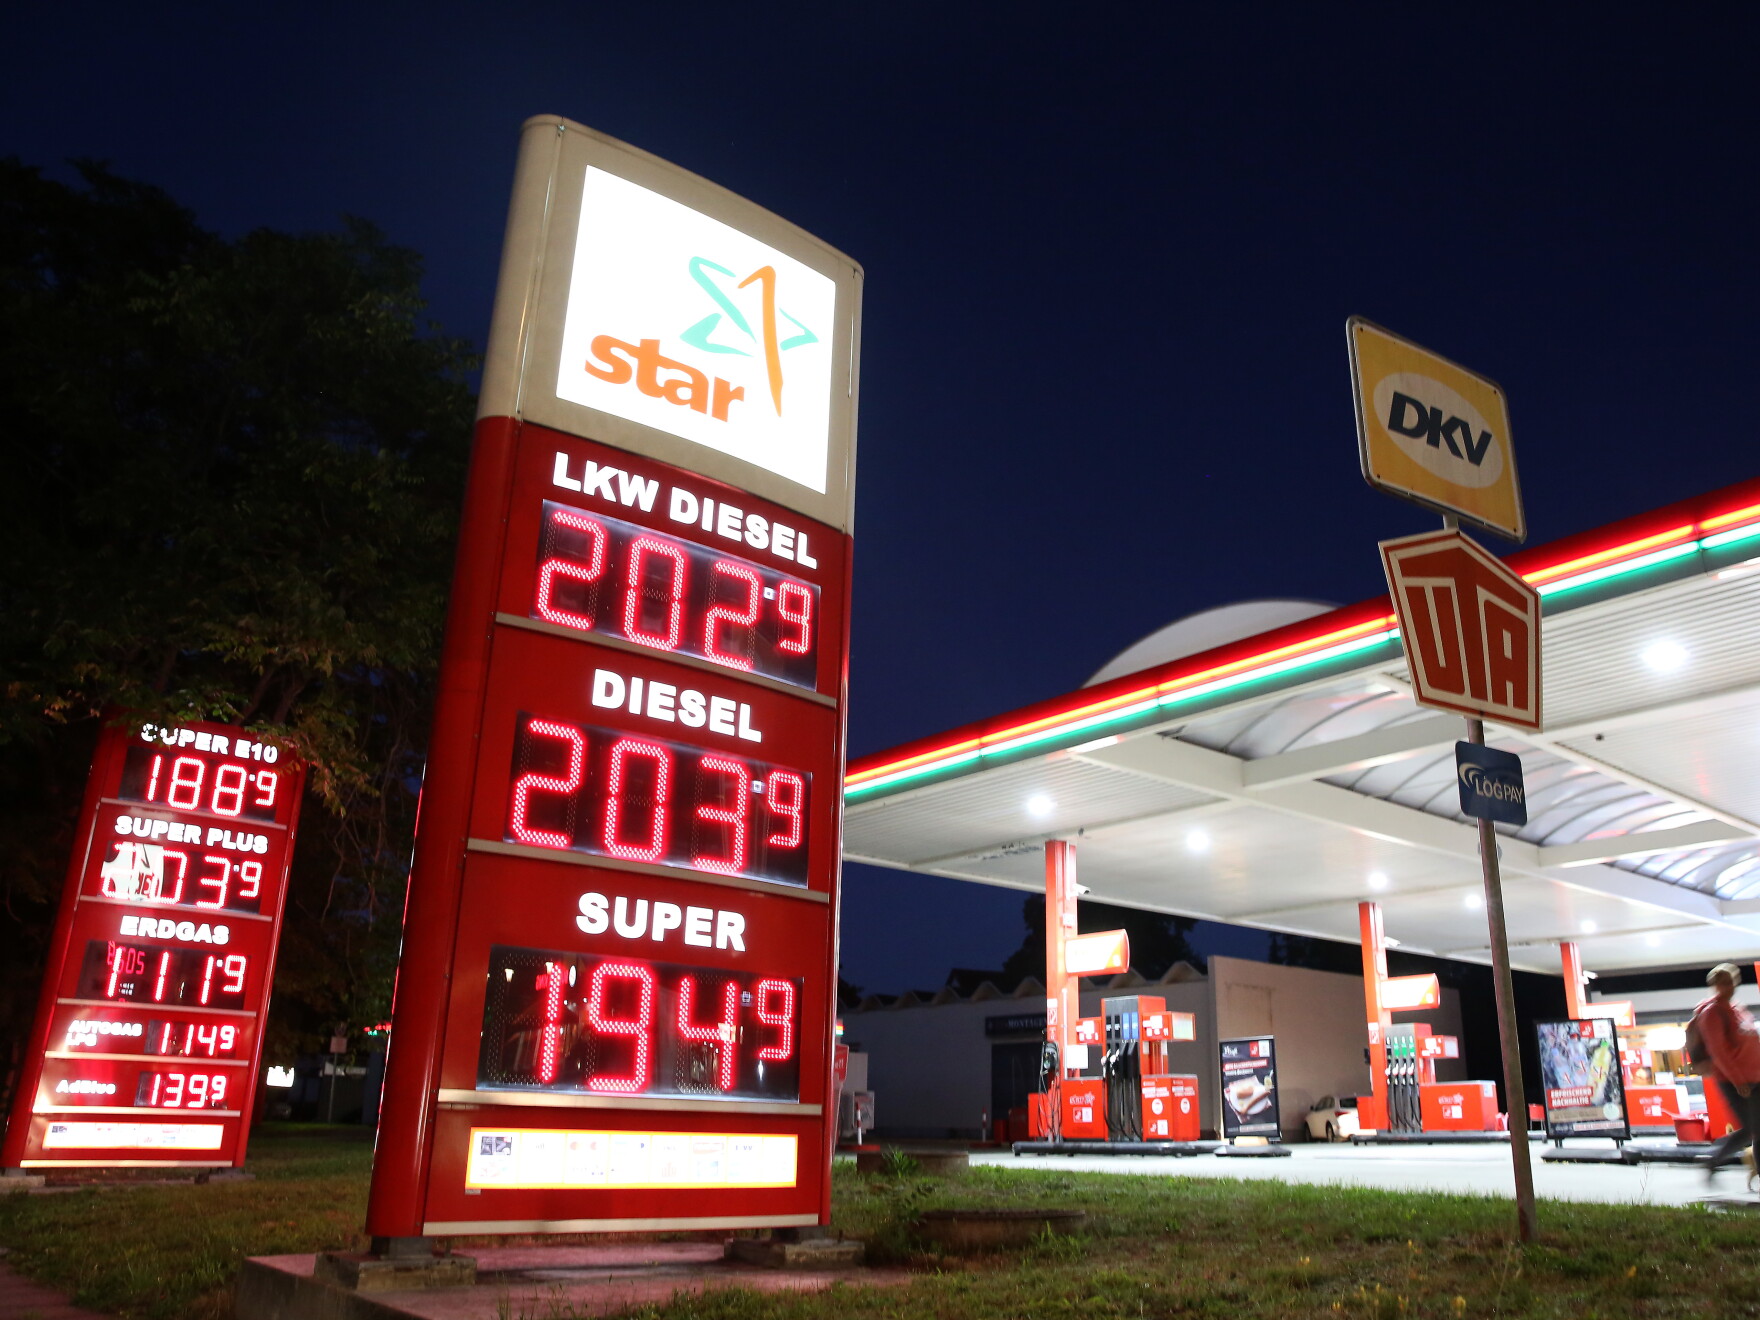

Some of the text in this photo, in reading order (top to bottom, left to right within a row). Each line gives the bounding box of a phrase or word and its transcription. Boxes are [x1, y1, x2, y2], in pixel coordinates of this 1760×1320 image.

[584, 334, 745, 423] star
[1387, 391, 1493, 467] DKV
[552, 451, 819, 570] LKW DIESEL
[590, 667, 764, 744] DIESEL
[234, 741, 279, 764] E10
[114, 815, 269, 854] SUPER PLUS
[119, 915, 230, 946] ERDGAS
[576, 892, 746, 952] SUPER
